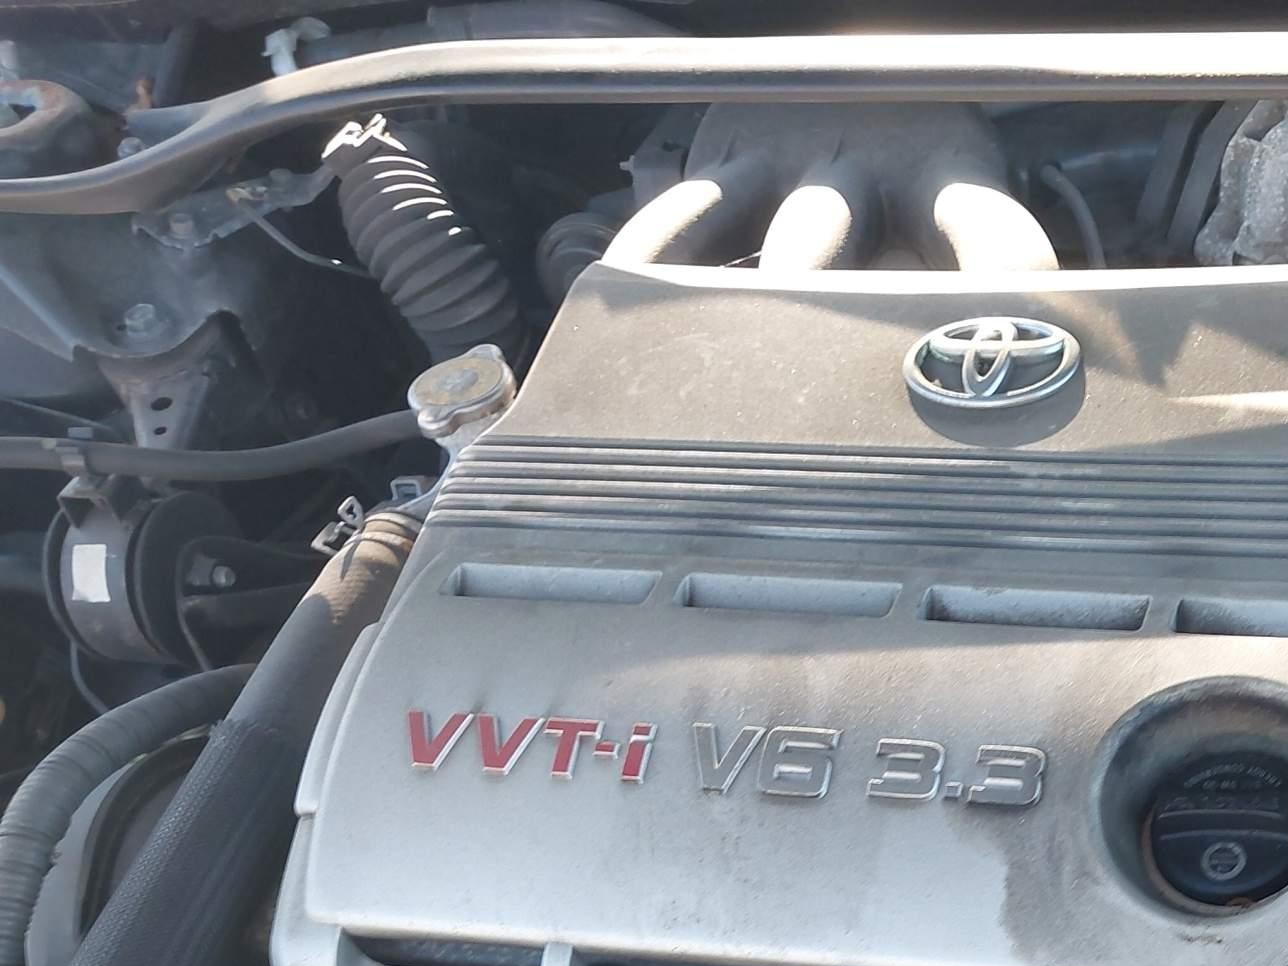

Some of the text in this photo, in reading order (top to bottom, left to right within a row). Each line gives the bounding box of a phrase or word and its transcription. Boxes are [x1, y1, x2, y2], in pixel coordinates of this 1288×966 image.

[408, 710, 1048, 806] VVT-i V6 3.3
